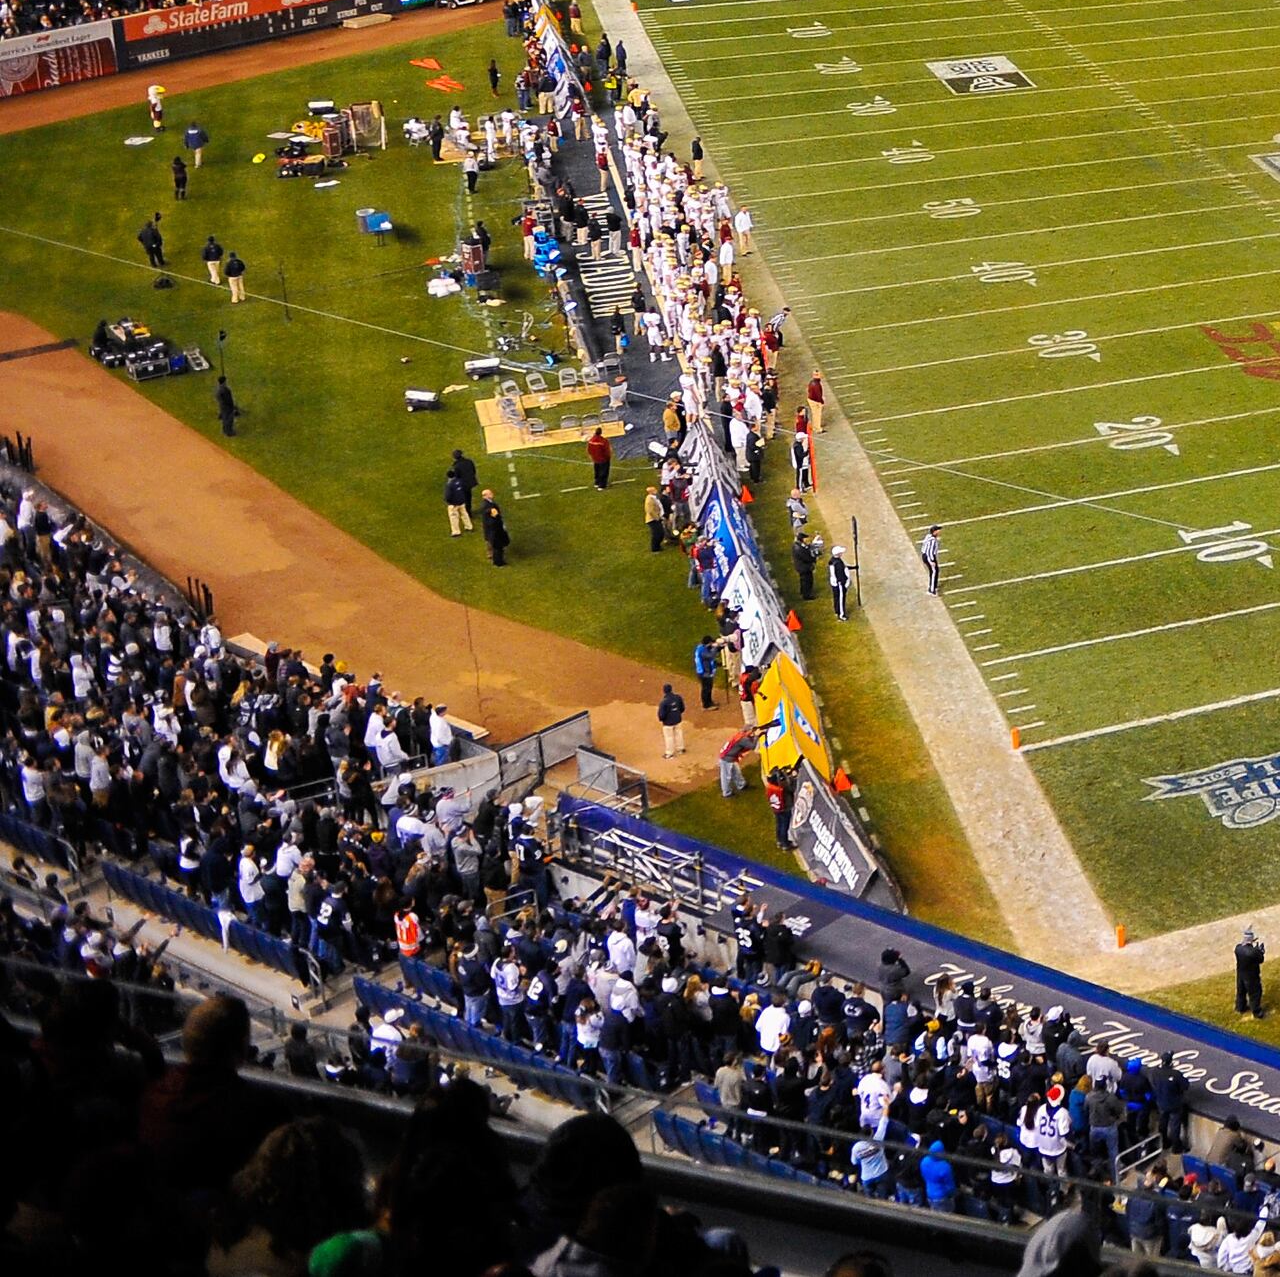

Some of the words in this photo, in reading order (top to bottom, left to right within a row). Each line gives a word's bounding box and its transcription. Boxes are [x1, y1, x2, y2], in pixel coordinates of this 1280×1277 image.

[137, 47, 170, 63] YANKEES
[1028, 330, 1097, 359] 30
[1093, 415, 1174, 450] 20
[1177, 520, 1270, 563] 10
[1039, 1117, 1056, 1137] 25
